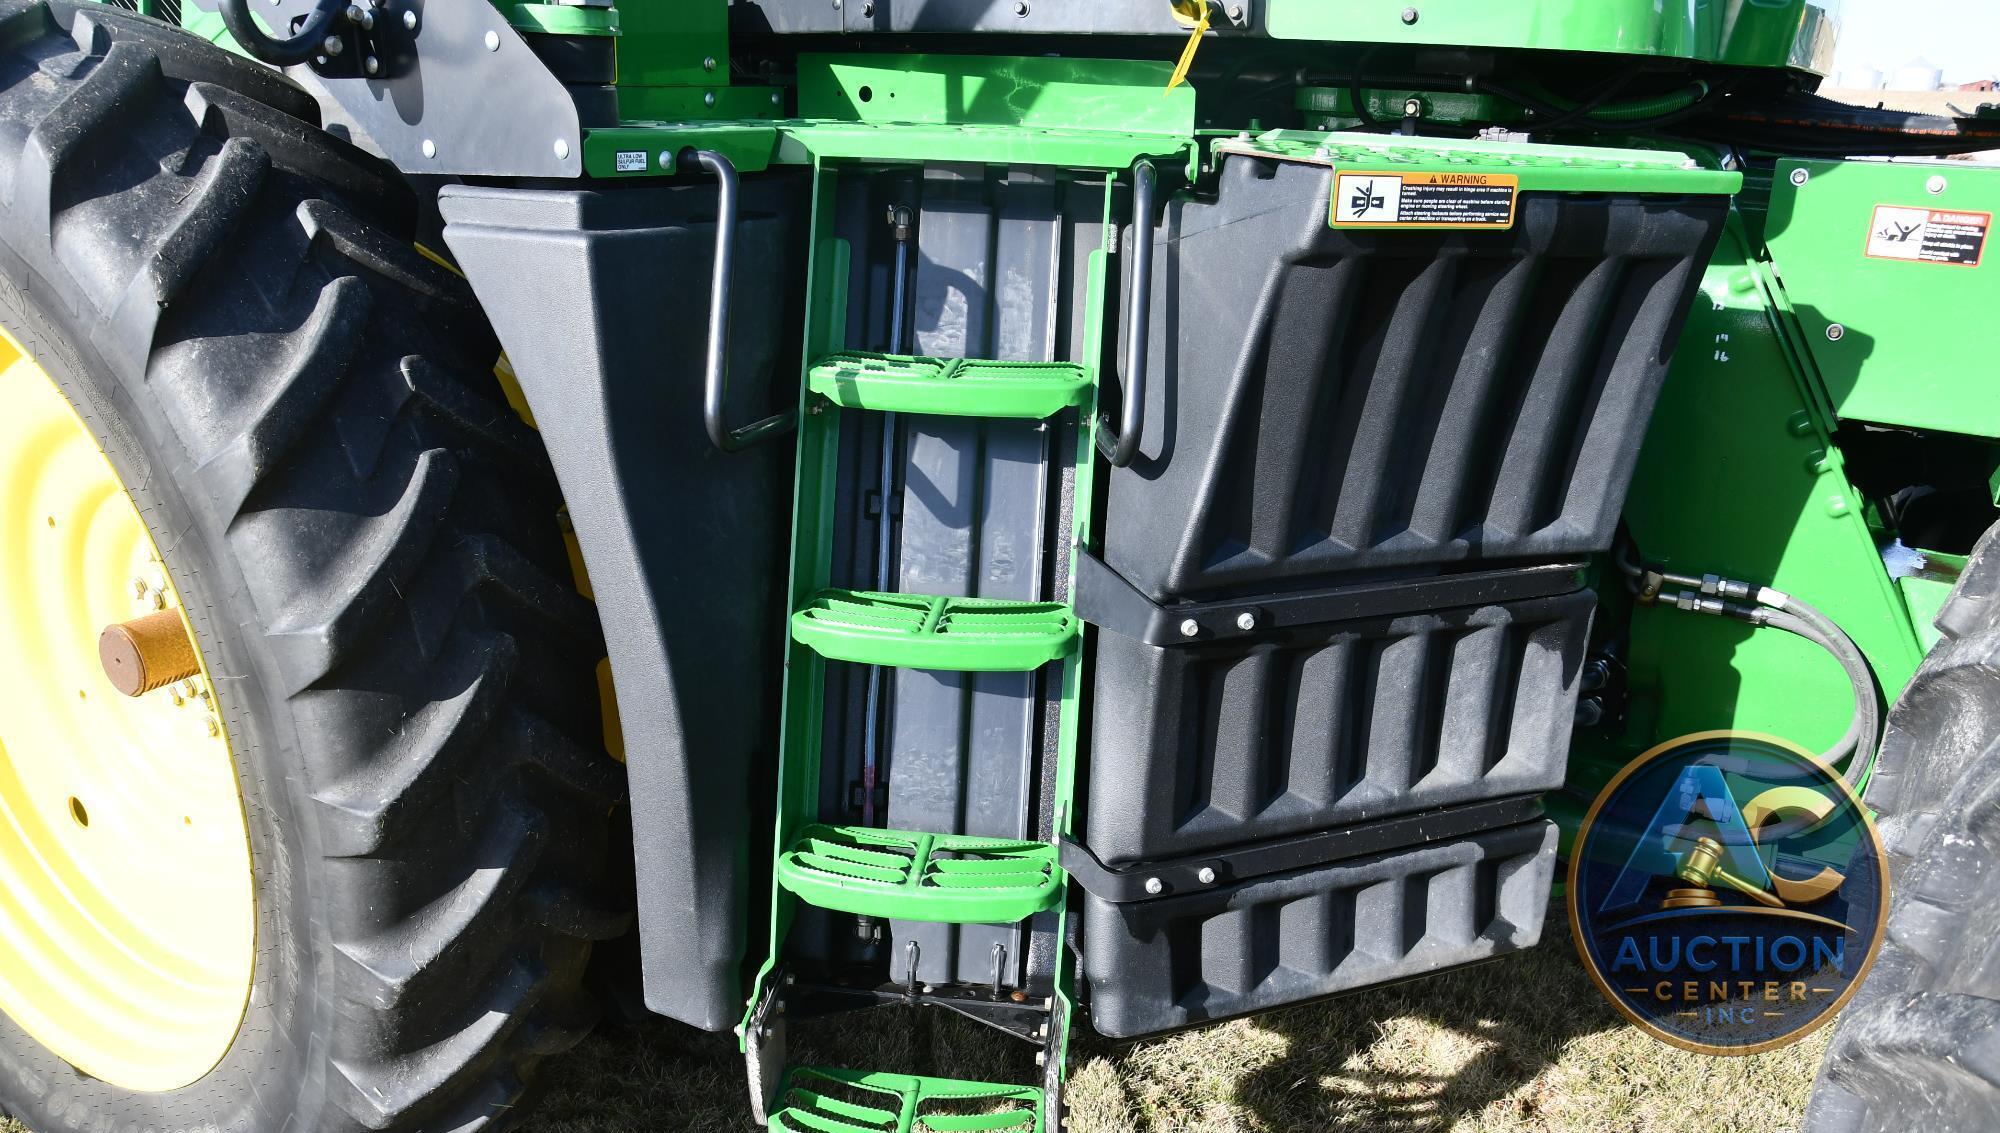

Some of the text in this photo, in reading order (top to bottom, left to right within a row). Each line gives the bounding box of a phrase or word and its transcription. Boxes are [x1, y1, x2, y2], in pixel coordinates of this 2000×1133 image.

[1441, 175, 1487, 184] WARNING
[1943, 214, 1984, 224] DANGER
[1714, 350, 1729, 362] 16
